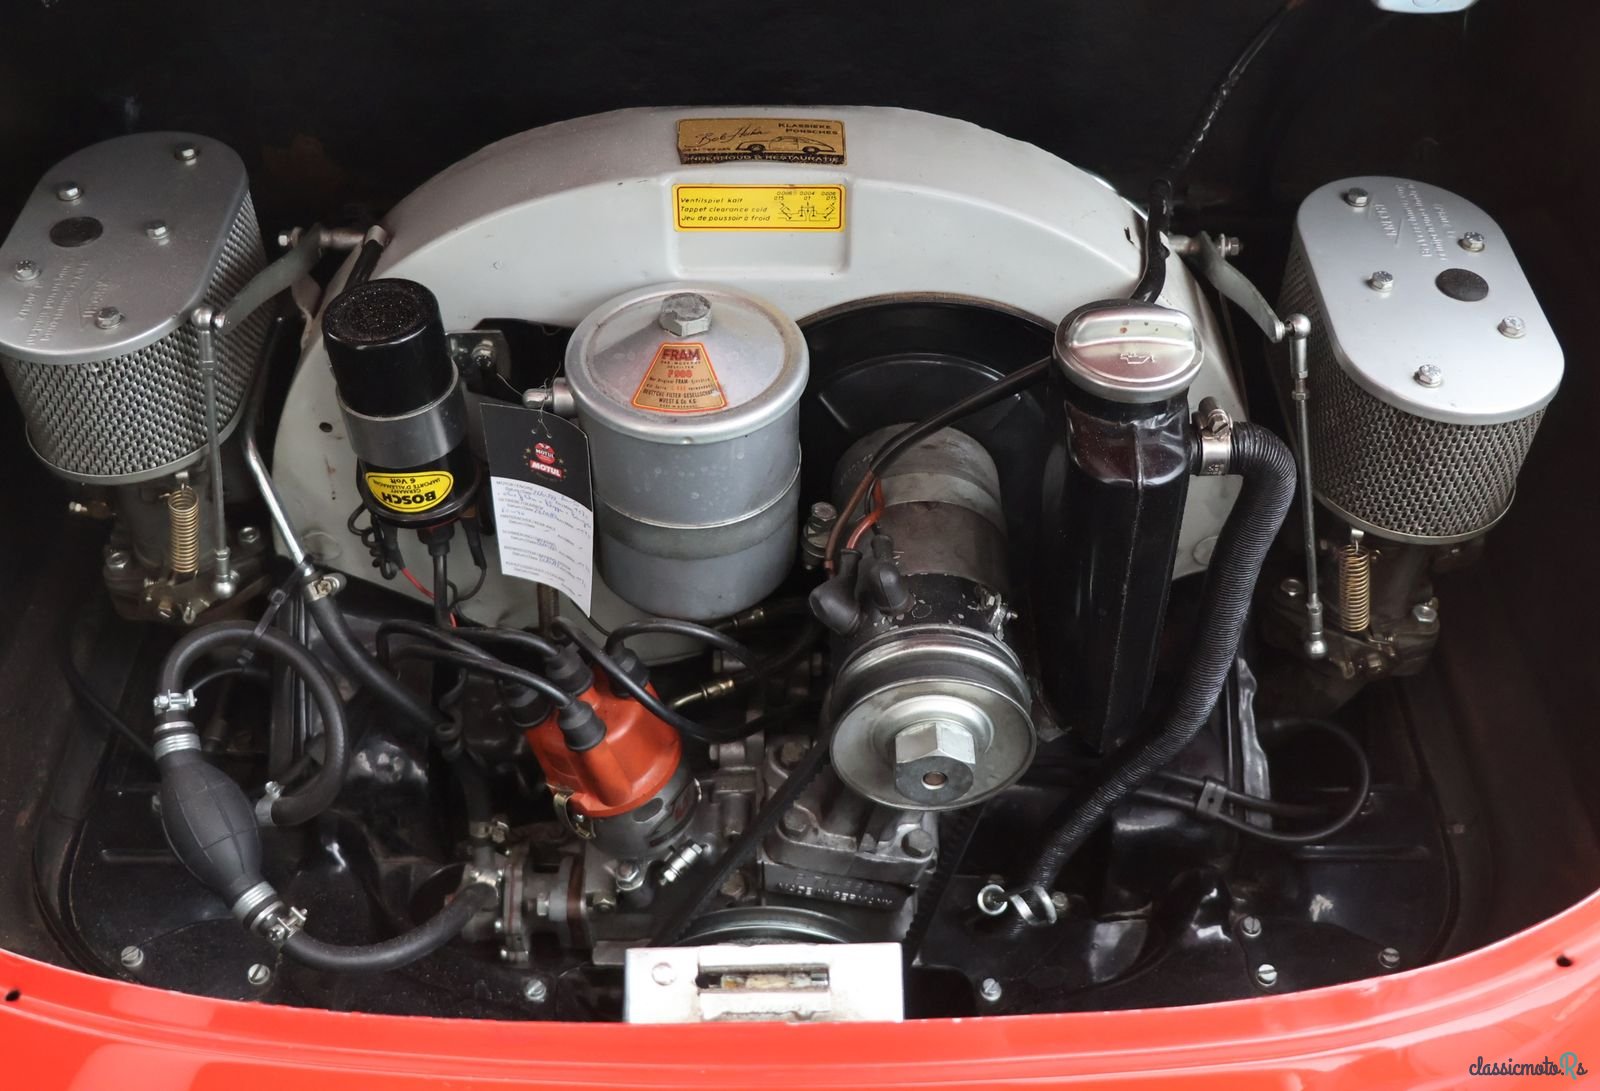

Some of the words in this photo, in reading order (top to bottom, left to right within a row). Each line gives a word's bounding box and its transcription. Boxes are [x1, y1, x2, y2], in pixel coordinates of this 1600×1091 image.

[661, 349, 701, 361] FRAM
[535, 448, 554, 458] MOTUL
[531, 461, 562, 477] MOTUL
[381, 490, 437, 504] BOSCH
